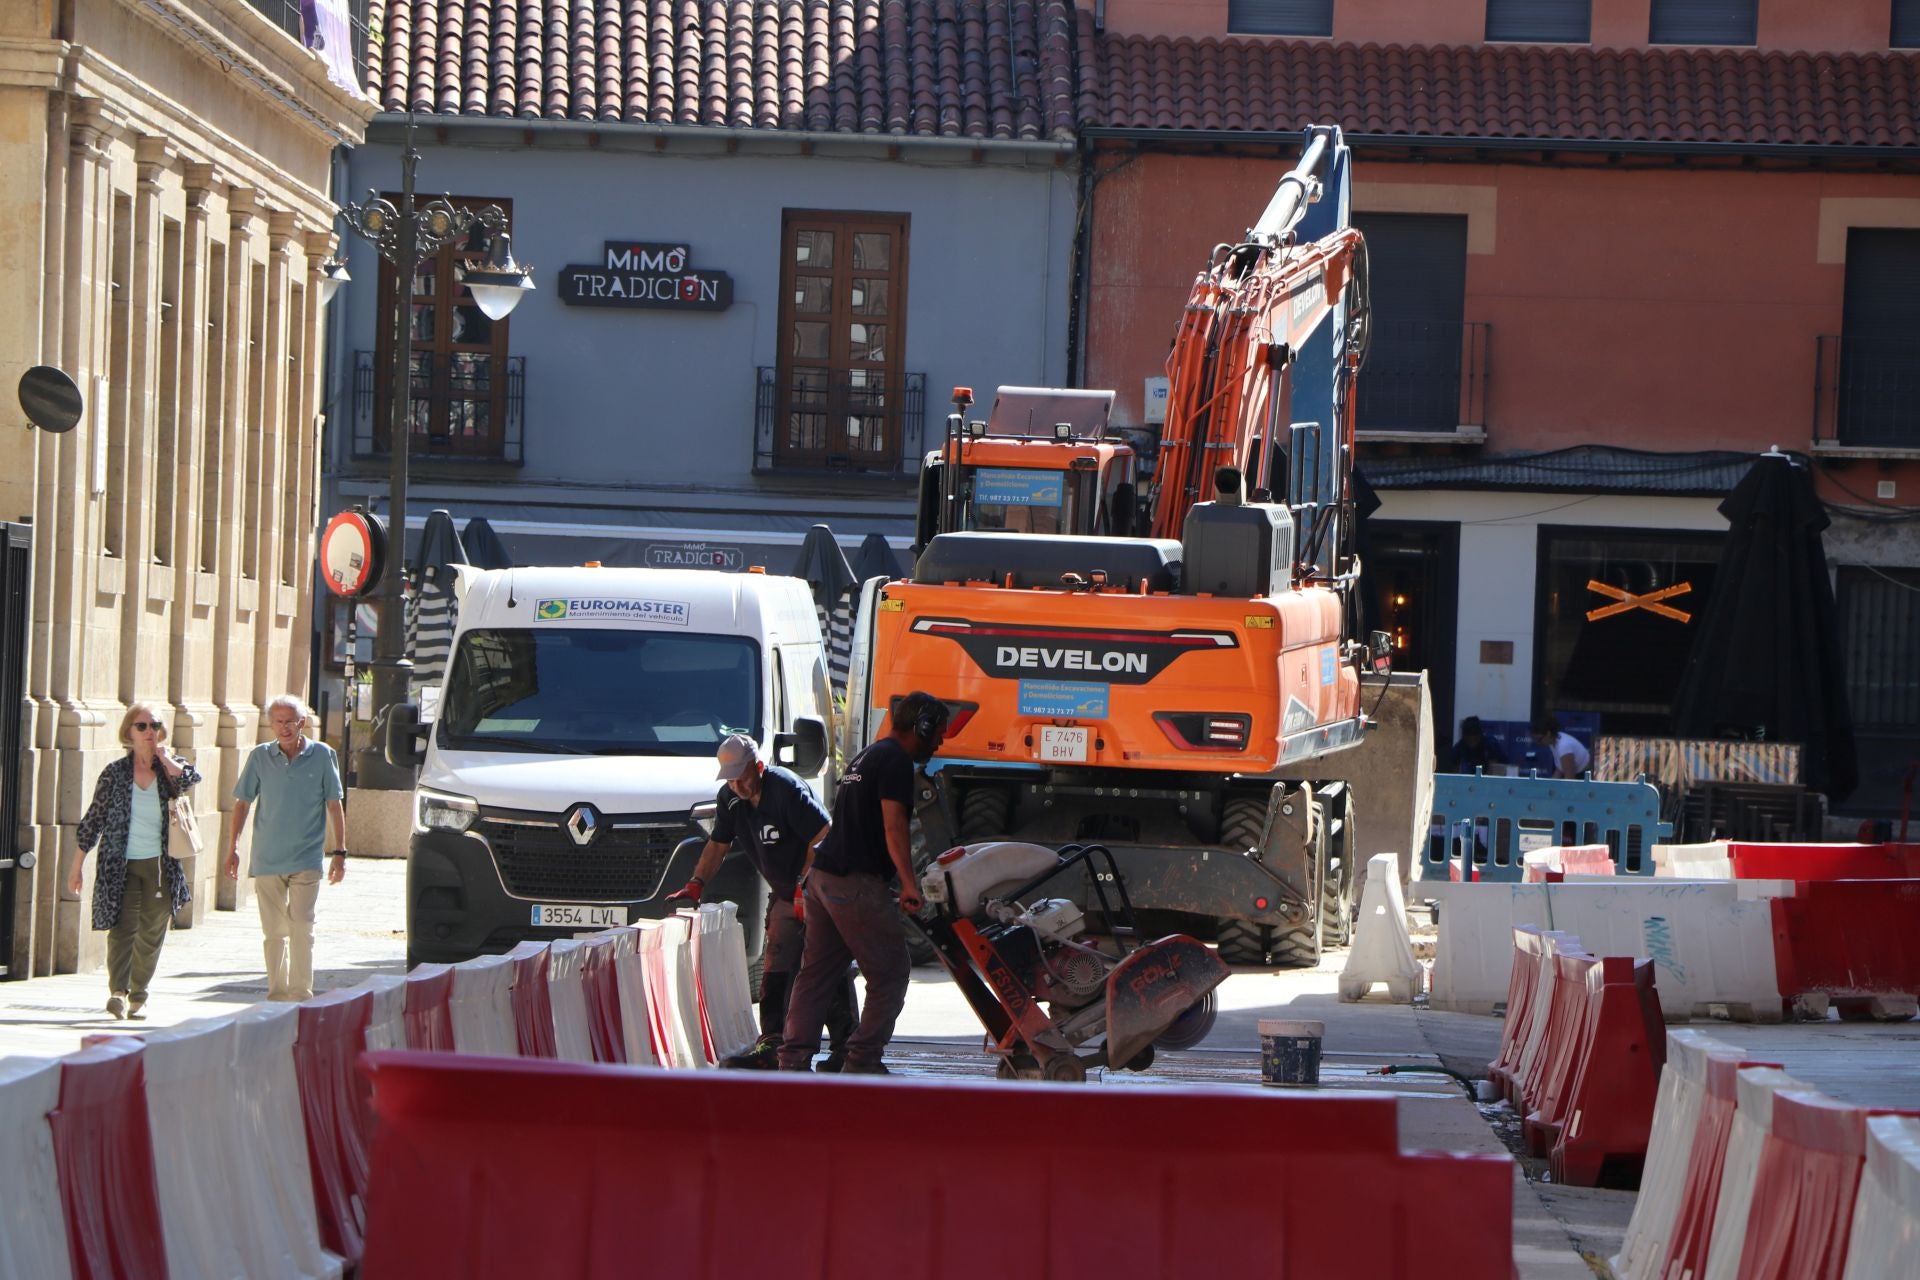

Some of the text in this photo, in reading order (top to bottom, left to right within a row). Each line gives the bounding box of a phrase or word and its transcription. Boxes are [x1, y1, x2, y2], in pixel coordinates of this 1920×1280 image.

[569, 600, 684, 615] EUROMASTER
[996, 646, 1148, 673] DEVELON
[1033, 706, 1046, 714] 987
[1045, 731, 1083, 743] E 7476
[1052, 746, 1074, 758] BHV
[544, 908, 619, 925] 3554 LVL
